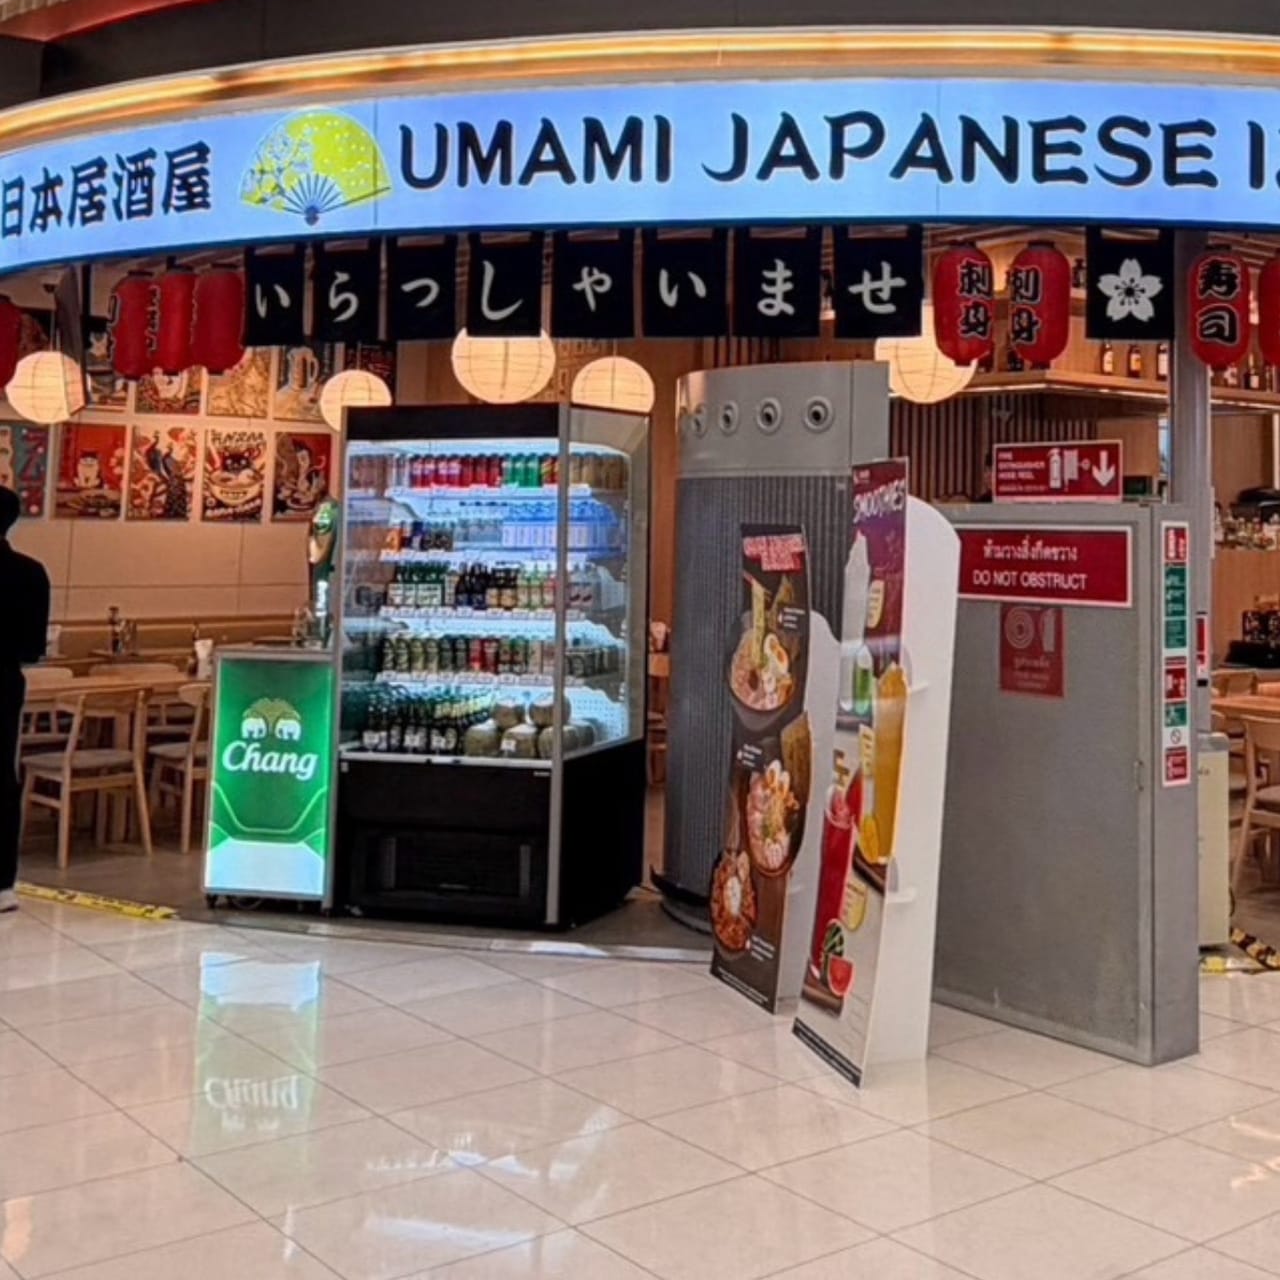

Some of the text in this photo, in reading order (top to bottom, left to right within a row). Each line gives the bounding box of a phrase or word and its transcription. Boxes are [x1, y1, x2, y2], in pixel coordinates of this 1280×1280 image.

[399, 112, 673, 191] UMAMI
[700, 110, 1219, 190] JAPANESE
[0, 141, 213, 239] 日本居酒屋
[972, 569, 1088, 590] DO NOT OBSTRUCT
[222, 741, 318, 782] Chang
